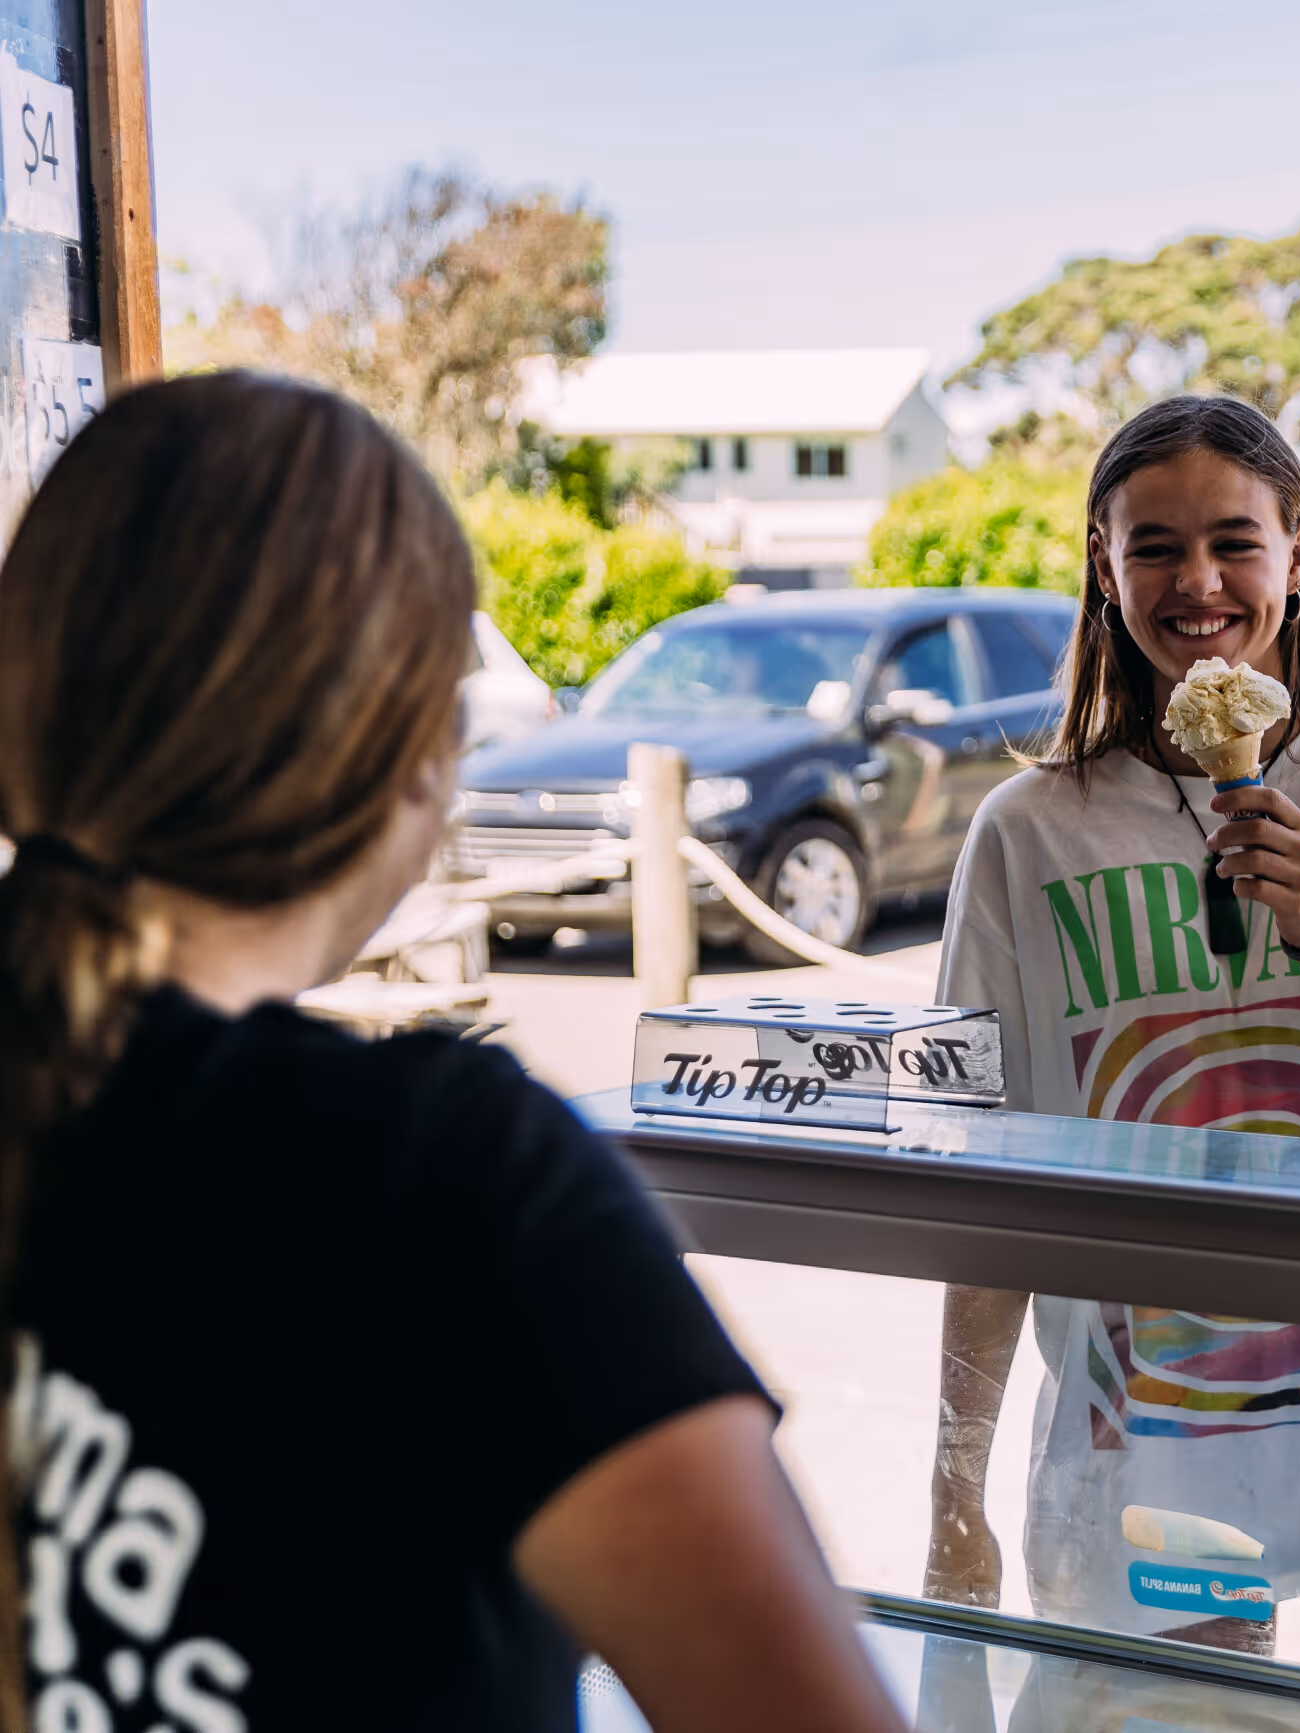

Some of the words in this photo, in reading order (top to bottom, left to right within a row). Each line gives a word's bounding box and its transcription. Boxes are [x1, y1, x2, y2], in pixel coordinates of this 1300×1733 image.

[21, 90, 59, 185] $4
[663, 1052, 737, 1107] Tip
[741, 1058, 827, 1114] Top
